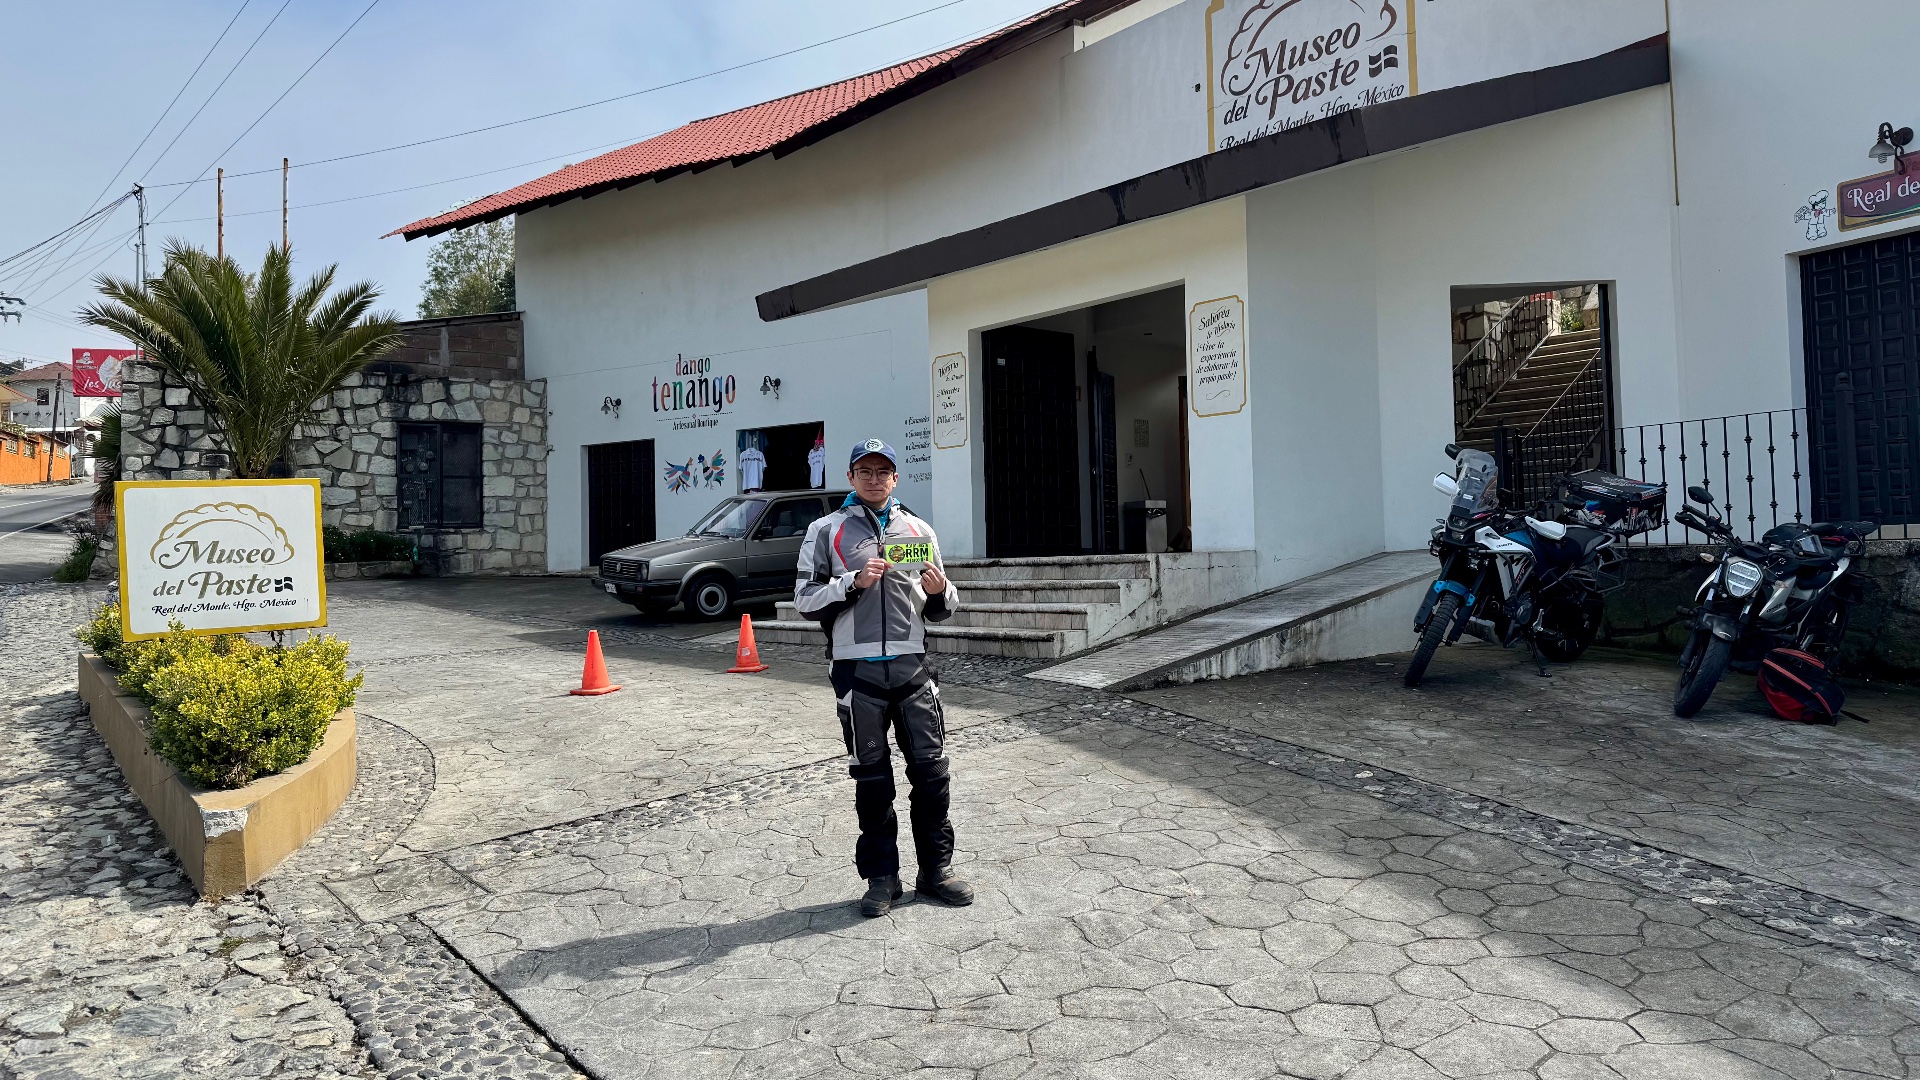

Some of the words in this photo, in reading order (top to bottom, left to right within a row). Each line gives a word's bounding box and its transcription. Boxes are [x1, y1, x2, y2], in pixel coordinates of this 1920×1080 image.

[1229, 22, 1361, 96] Museo
[1223, 94, 1251, 126] del
[1255, 58, 1360, 121] Paste
[1847, 180, 1892, 212] Real
[675, 353, 711, 378] dango
[651, 374, 736, 413] tenango
[672, 419, 697, 431] Artesanal
[158, 540, 276, 570] Museo
[905, 547, 929, 558] RRM
[152, 579, 185, 597] del
[187, 570, 272, 600] Paste
[151, 604, 177, 616] Real
[177, 603, 191, 613] del
